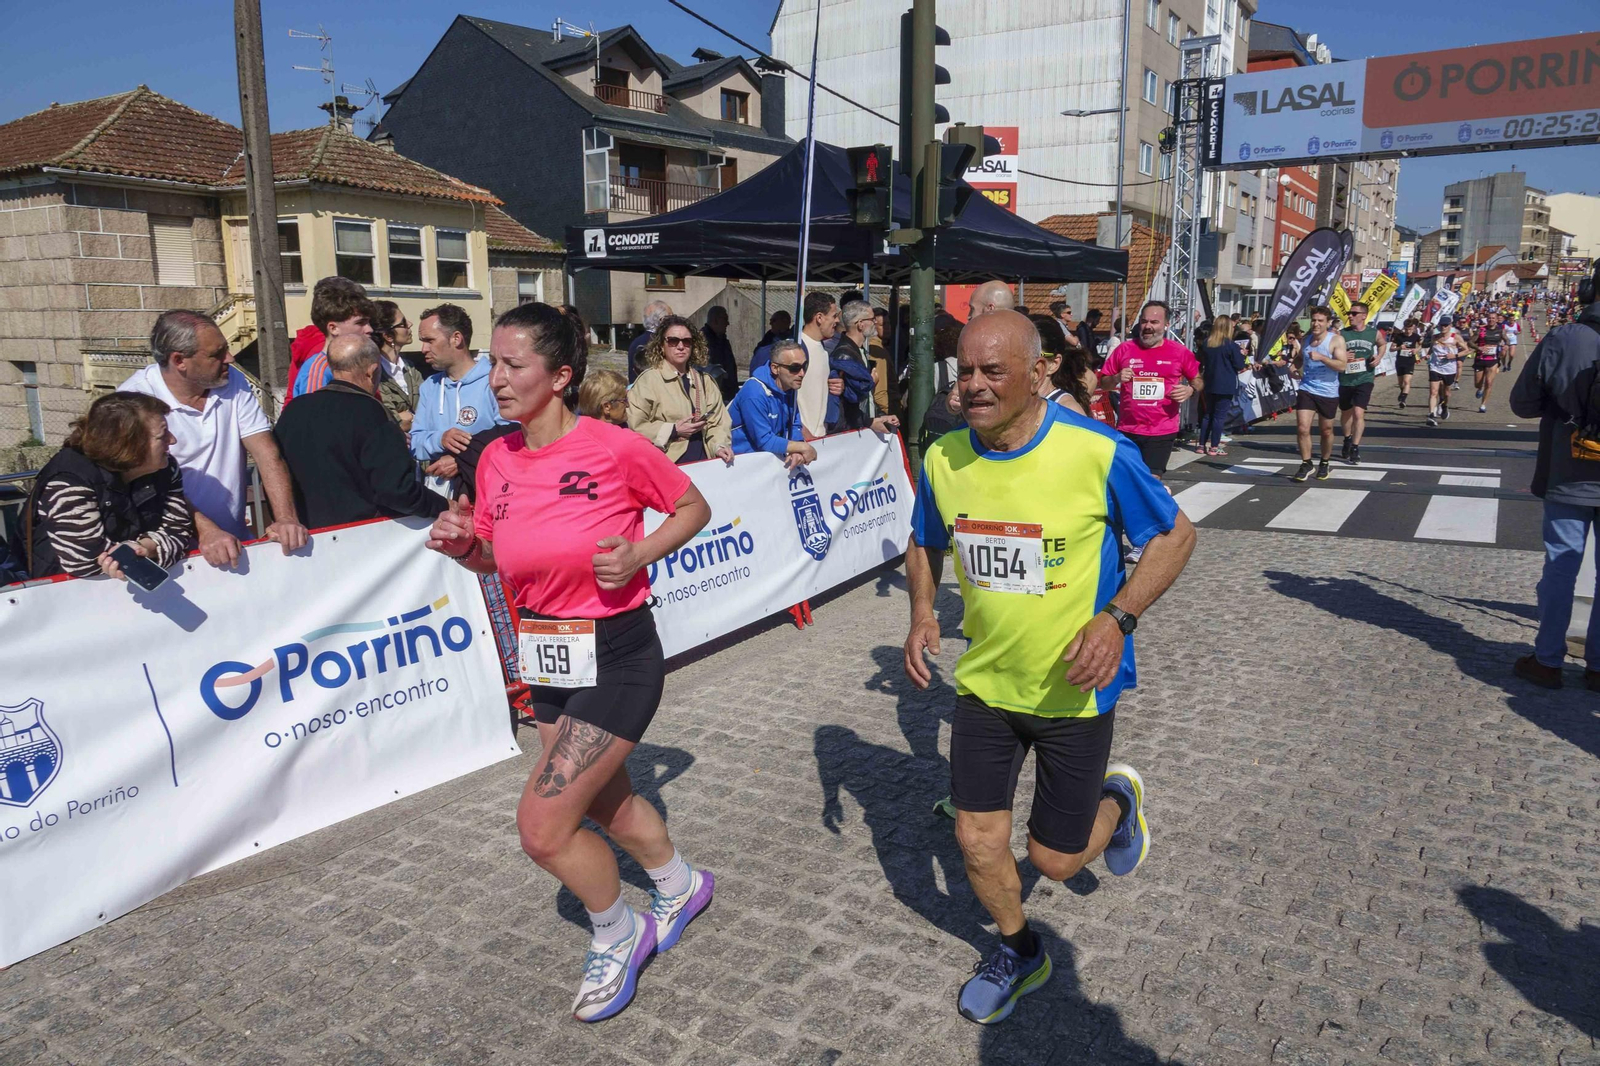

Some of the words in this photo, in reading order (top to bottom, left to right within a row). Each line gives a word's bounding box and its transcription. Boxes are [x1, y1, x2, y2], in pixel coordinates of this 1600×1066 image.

[1261, 81, 1355, 114] LASAL
[1320, 107, 1355, 117] cocinas
[1209, 101, 1219, 158] CCNORTE
[1503, 112, 1600, 139] 00:25:2
[608, 232, 660, 246] CCNORTE
[1281, 247, 1333, 307] LASAL
[1140, 385, 1157, 396] 667
[664, 523, 754, 579] Porriño
[985, 536, 1006, 545] BERTO
[968, 544, 1027, 580] 1054
[273, 604, 473, 703] Porriño
[536, 644, 571, 675] 159
[29, 811, 59, 832] do
[66, 786, 140, 820] Porriño
